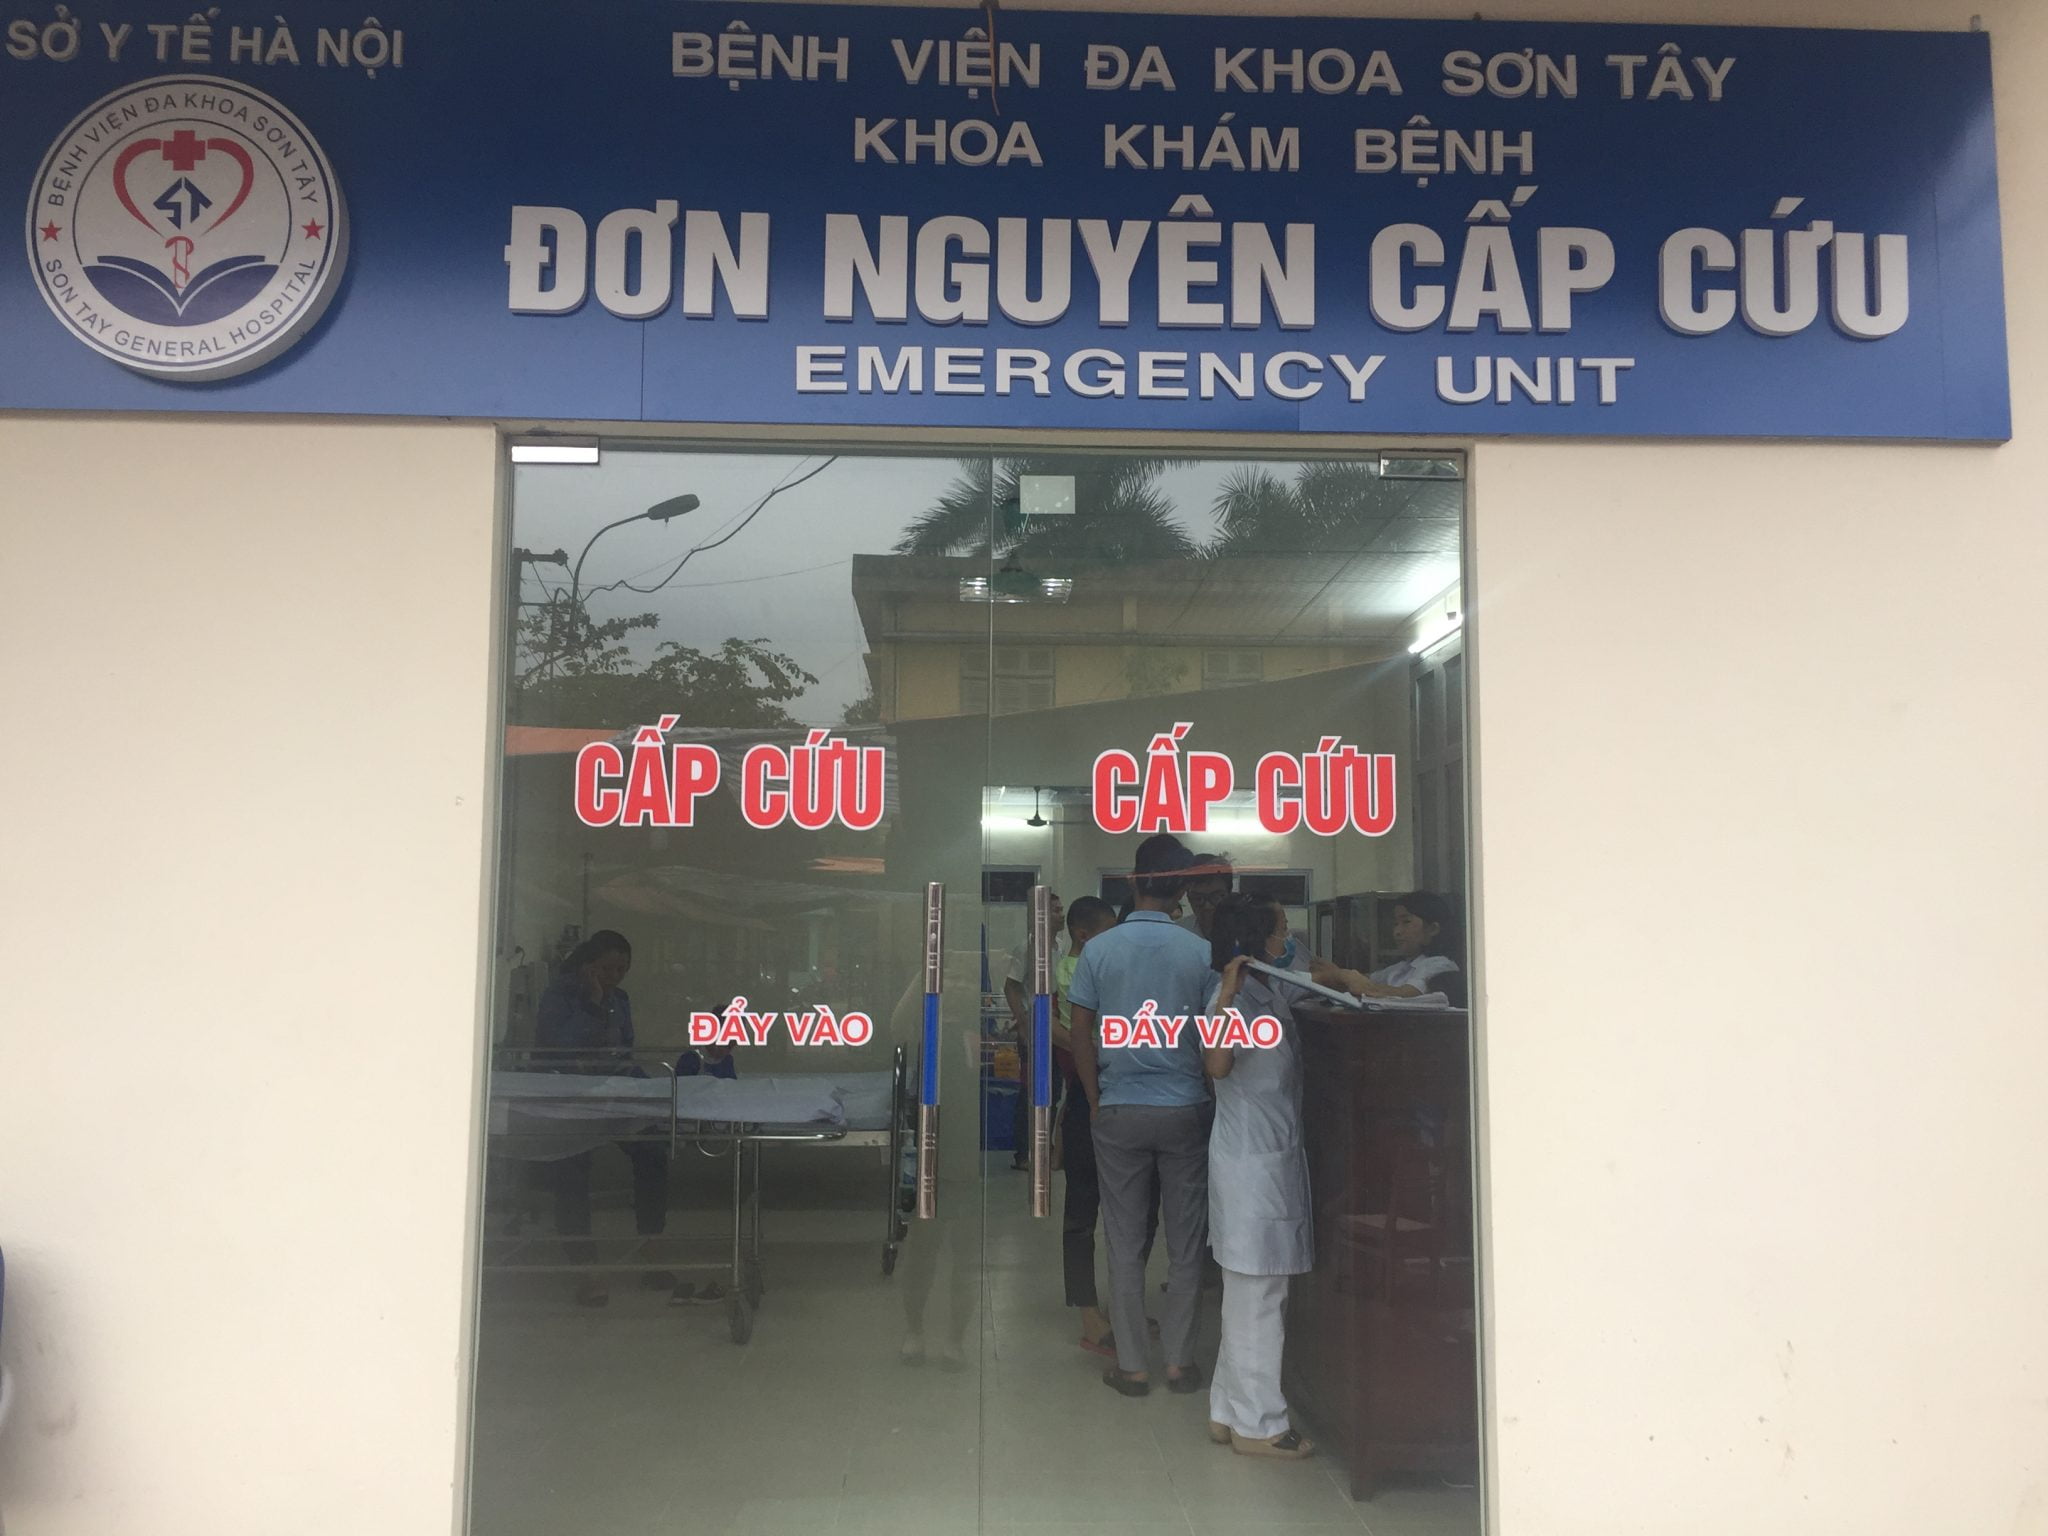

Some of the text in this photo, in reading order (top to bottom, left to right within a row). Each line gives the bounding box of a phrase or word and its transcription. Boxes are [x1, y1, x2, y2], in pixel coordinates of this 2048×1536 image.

[5, 4, 404, 79] SỞ Y TẾ HÀ NỘI
[671, 20, 1737, 101] BỆNH VIỆN ĐA KHOA SƠN TÂY
[144, 93, 178, 114] ĐA
[183, 92, 251, 124] KHOA
[252, 115, 298, 160] SƠN
[853, 112, 1535, 187] KHOA KHÁM BỆNH
[504, 185, 1909, 339] ĐƠN NGUYÊN CẤP CỨU
[46, 256, 317, 358] SON TAY GENERAL HOSPITAL
[795, 344, 1636, 405] EMERGENCY UNIT
[574, 713, 887, 831] CẤP CỨU
[1092, 721, 1398, 837] CẤP CỨU
[688, 996, 874, 1047] ĐẨY VÀO
[1100, 999, 1284, 1050] ĐẨY VÀO
